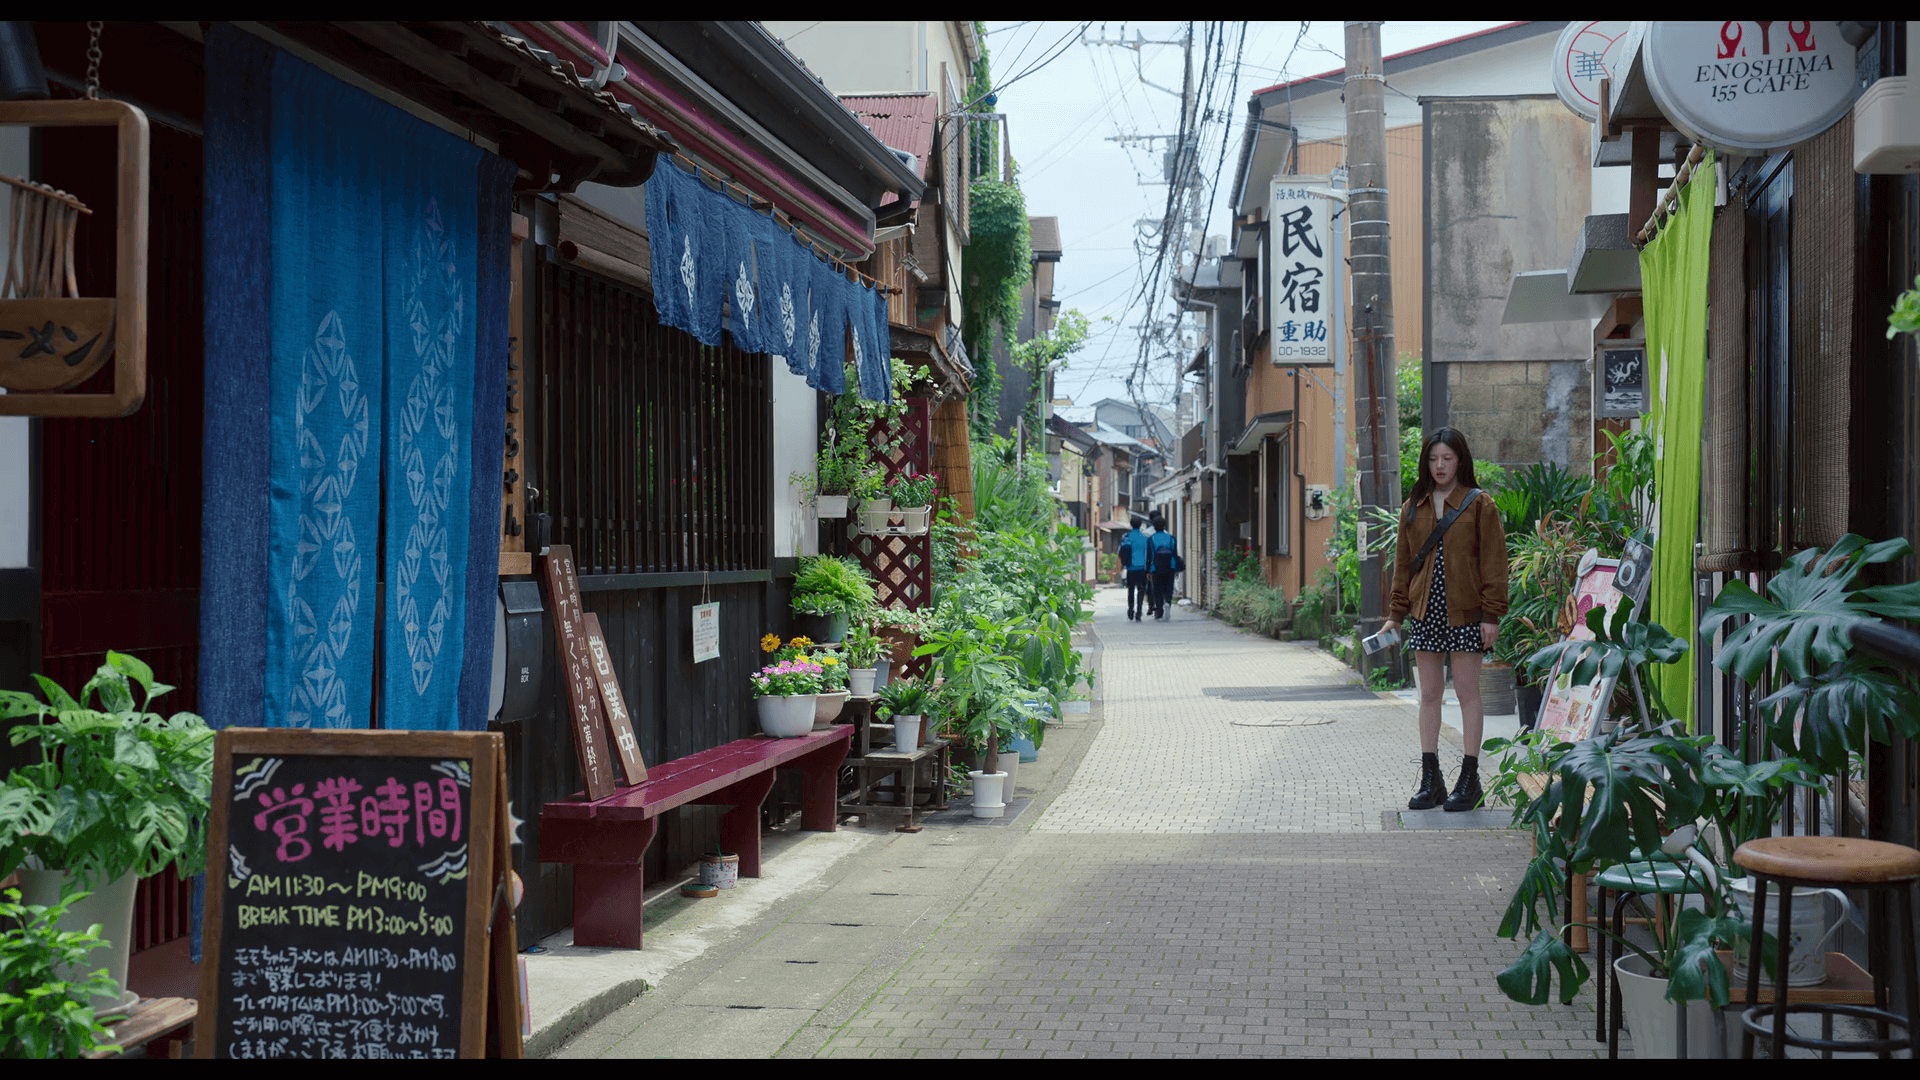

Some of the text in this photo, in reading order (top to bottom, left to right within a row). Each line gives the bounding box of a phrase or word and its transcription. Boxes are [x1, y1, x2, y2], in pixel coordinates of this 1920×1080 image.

[1694, 54, 1834, 83] ENOSHIMA
[1711, 73, 1810, 102] 155 CAFE
[1280, 205, 1324, 314] 民宿
[1277, 320, 1327, 342] 重助
[589, 635, 635, 764] 営業中
[253, 776, 462, 862] 営業時間
[238, 905, 290, 929] BREAK
[291, 905, 340, 927] TIME
[232, 1013, 439, 1047] ご利用の際はご不便をおかけ
